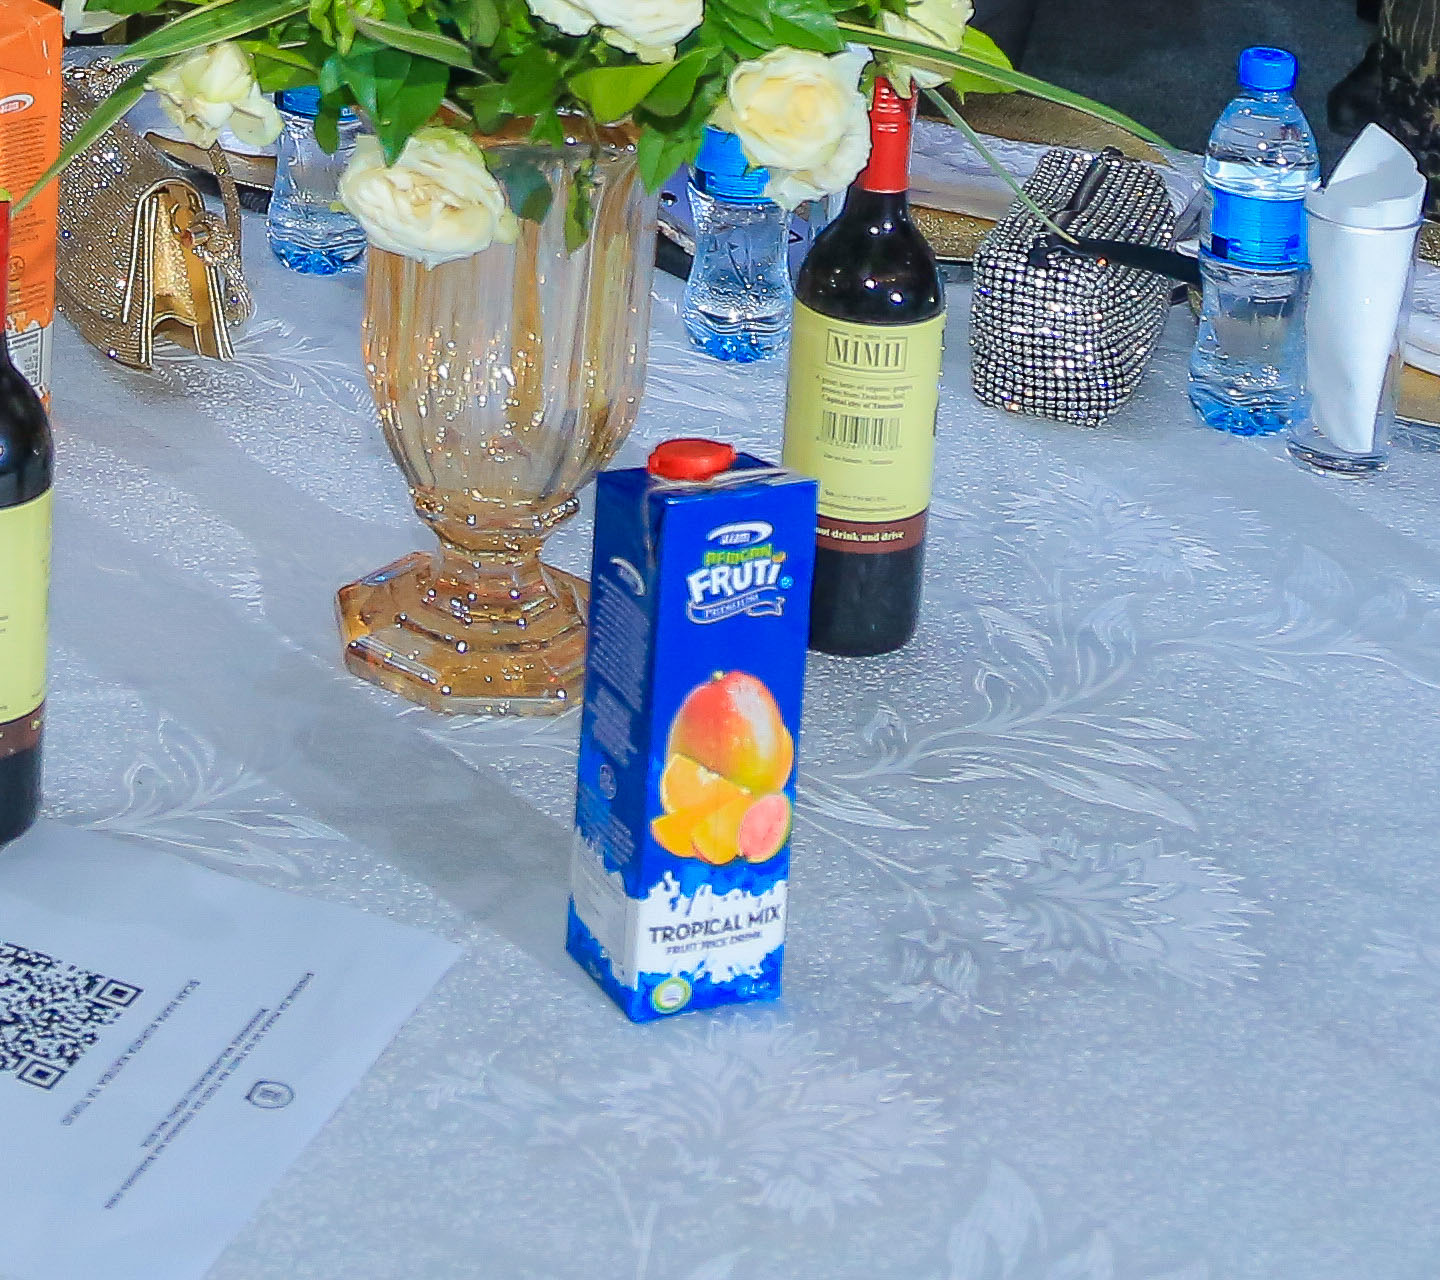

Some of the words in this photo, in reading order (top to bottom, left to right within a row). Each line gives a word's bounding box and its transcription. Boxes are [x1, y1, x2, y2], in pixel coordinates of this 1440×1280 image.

[831, 529, 860, 542] drink
[861, 531, 880, 542] and
[687, 559, 781, 603] FRUTI
[649, 914, 743, 944] TROPICAL
[748, 904, 782, 928] MIX
